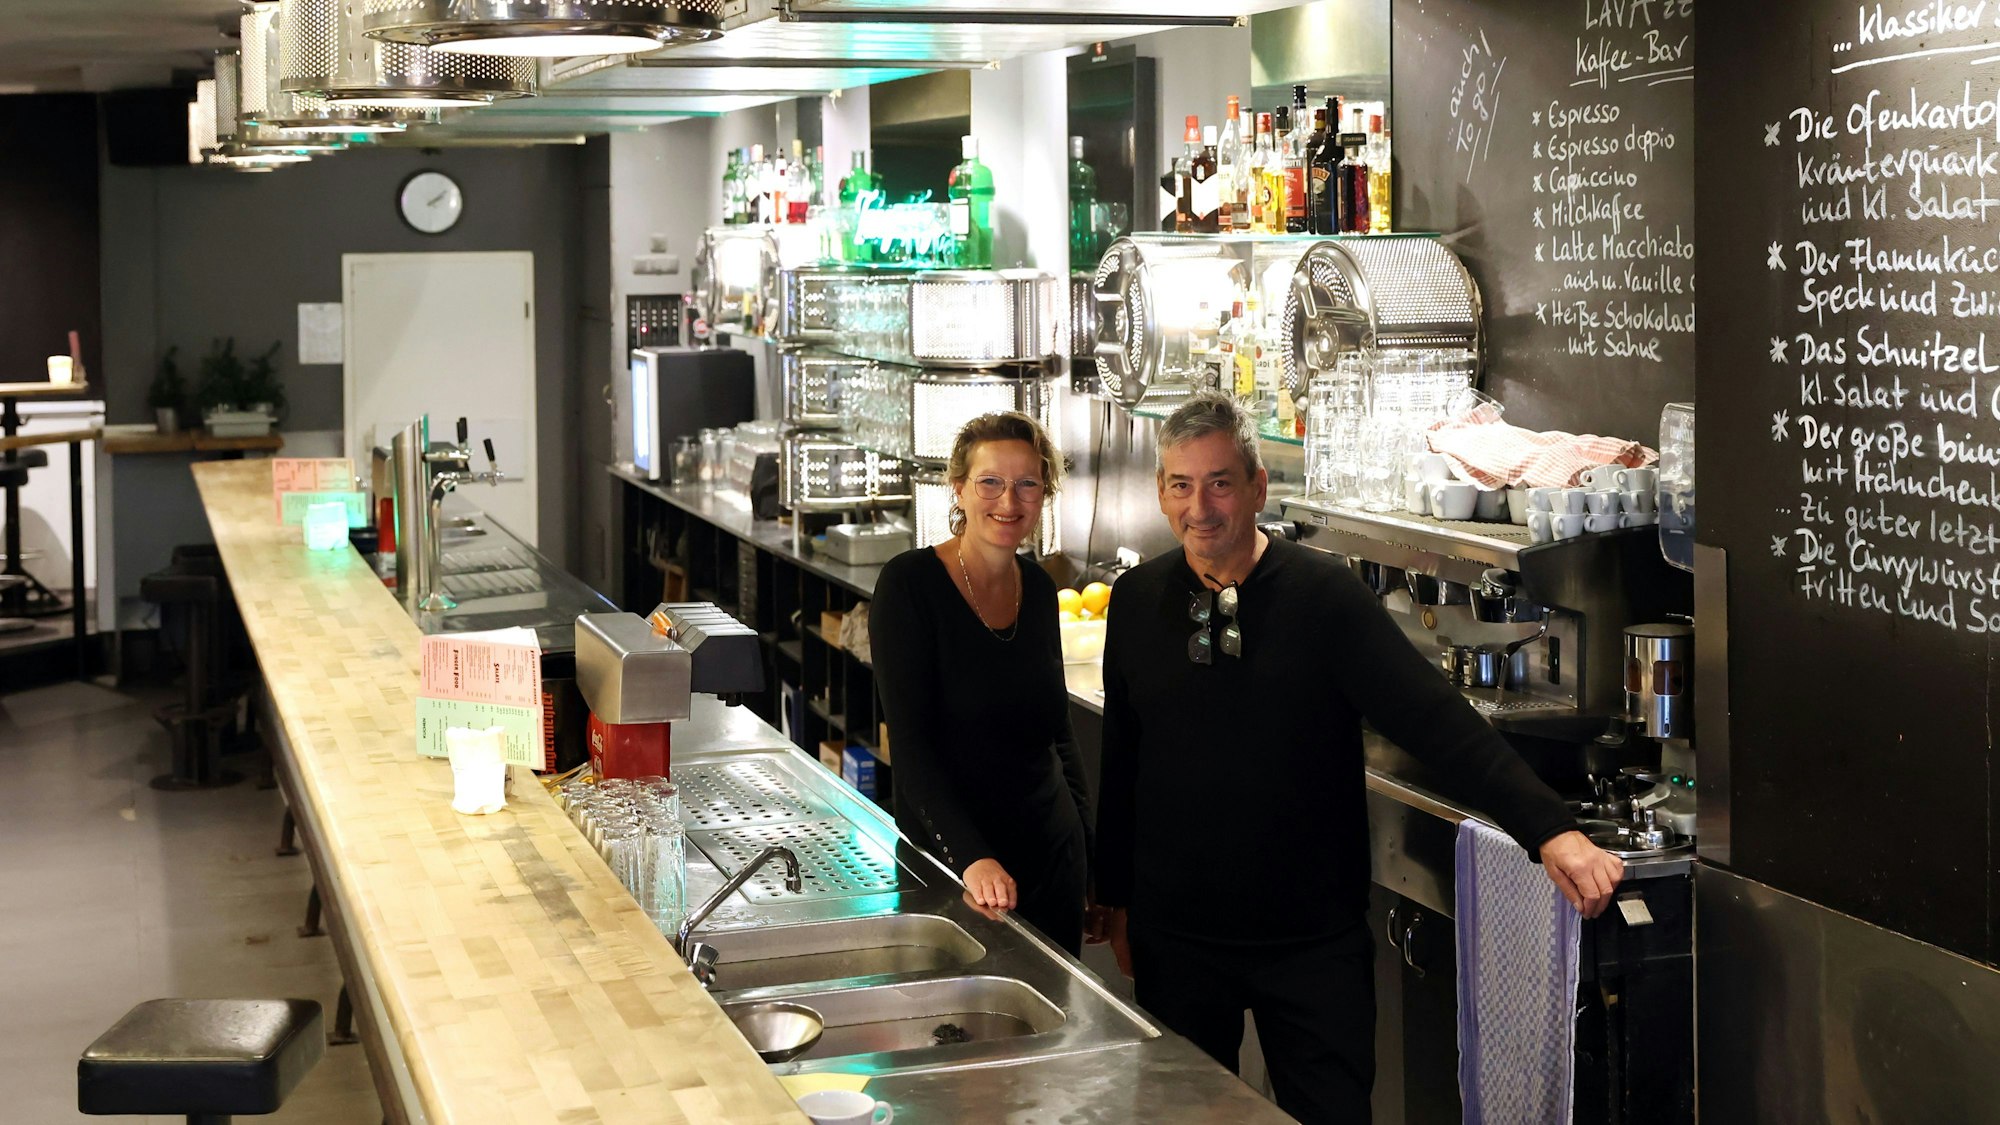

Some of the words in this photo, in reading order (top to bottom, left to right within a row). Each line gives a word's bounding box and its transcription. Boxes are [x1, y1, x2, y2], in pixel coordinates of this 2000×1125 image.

[1549, 100, 1620, 138] Espresso
[1789, 107, 1838, 142] Die
[1548, 134, 1619, 172] Espresso
[1624, 124, 1675, 162] doppio
[1552, 192, 1645, 235] Milchkaffee
[1803, 184, 1851, 225] und
[1905, 181, 2000, 223] Salat
[1553, 230, 1598, 262] Latte
[1602, 225, 1694, 260] Macchiato
[1796, 240, 1841, 276] Der
[1845, 235, 2000, 274] Flammkuc
[1625, 262, 1683, 294] Vanille
[1552, 300, 1600, 334] Heiße
[1797, 273, 1876, 328] Speck
[1880, 282, 1937, 317] und
[1950, 280, 2000, 318] Zwi
[1603, 331, 1663, 362] Sahne
[1796, 333, 1847, 366] Das
[1857, 324, 2000, 374] Schnitzel
[1834, 372, 1910, 410] Salat
[1920, 376, 1978, 419] und
[1798, 414, 1844, 450] Der
[1850, 421, 1926, 465] große
[1937, 422, 2000, 467] bun
[1802, 453, 1849, 485] mit
[1845, 498, 1921, 548] guter
[1794, 527, 1837, 565] Die
[1796, 565, 1893, 614] Fritten
[1897, 589, 1957, 630] und
